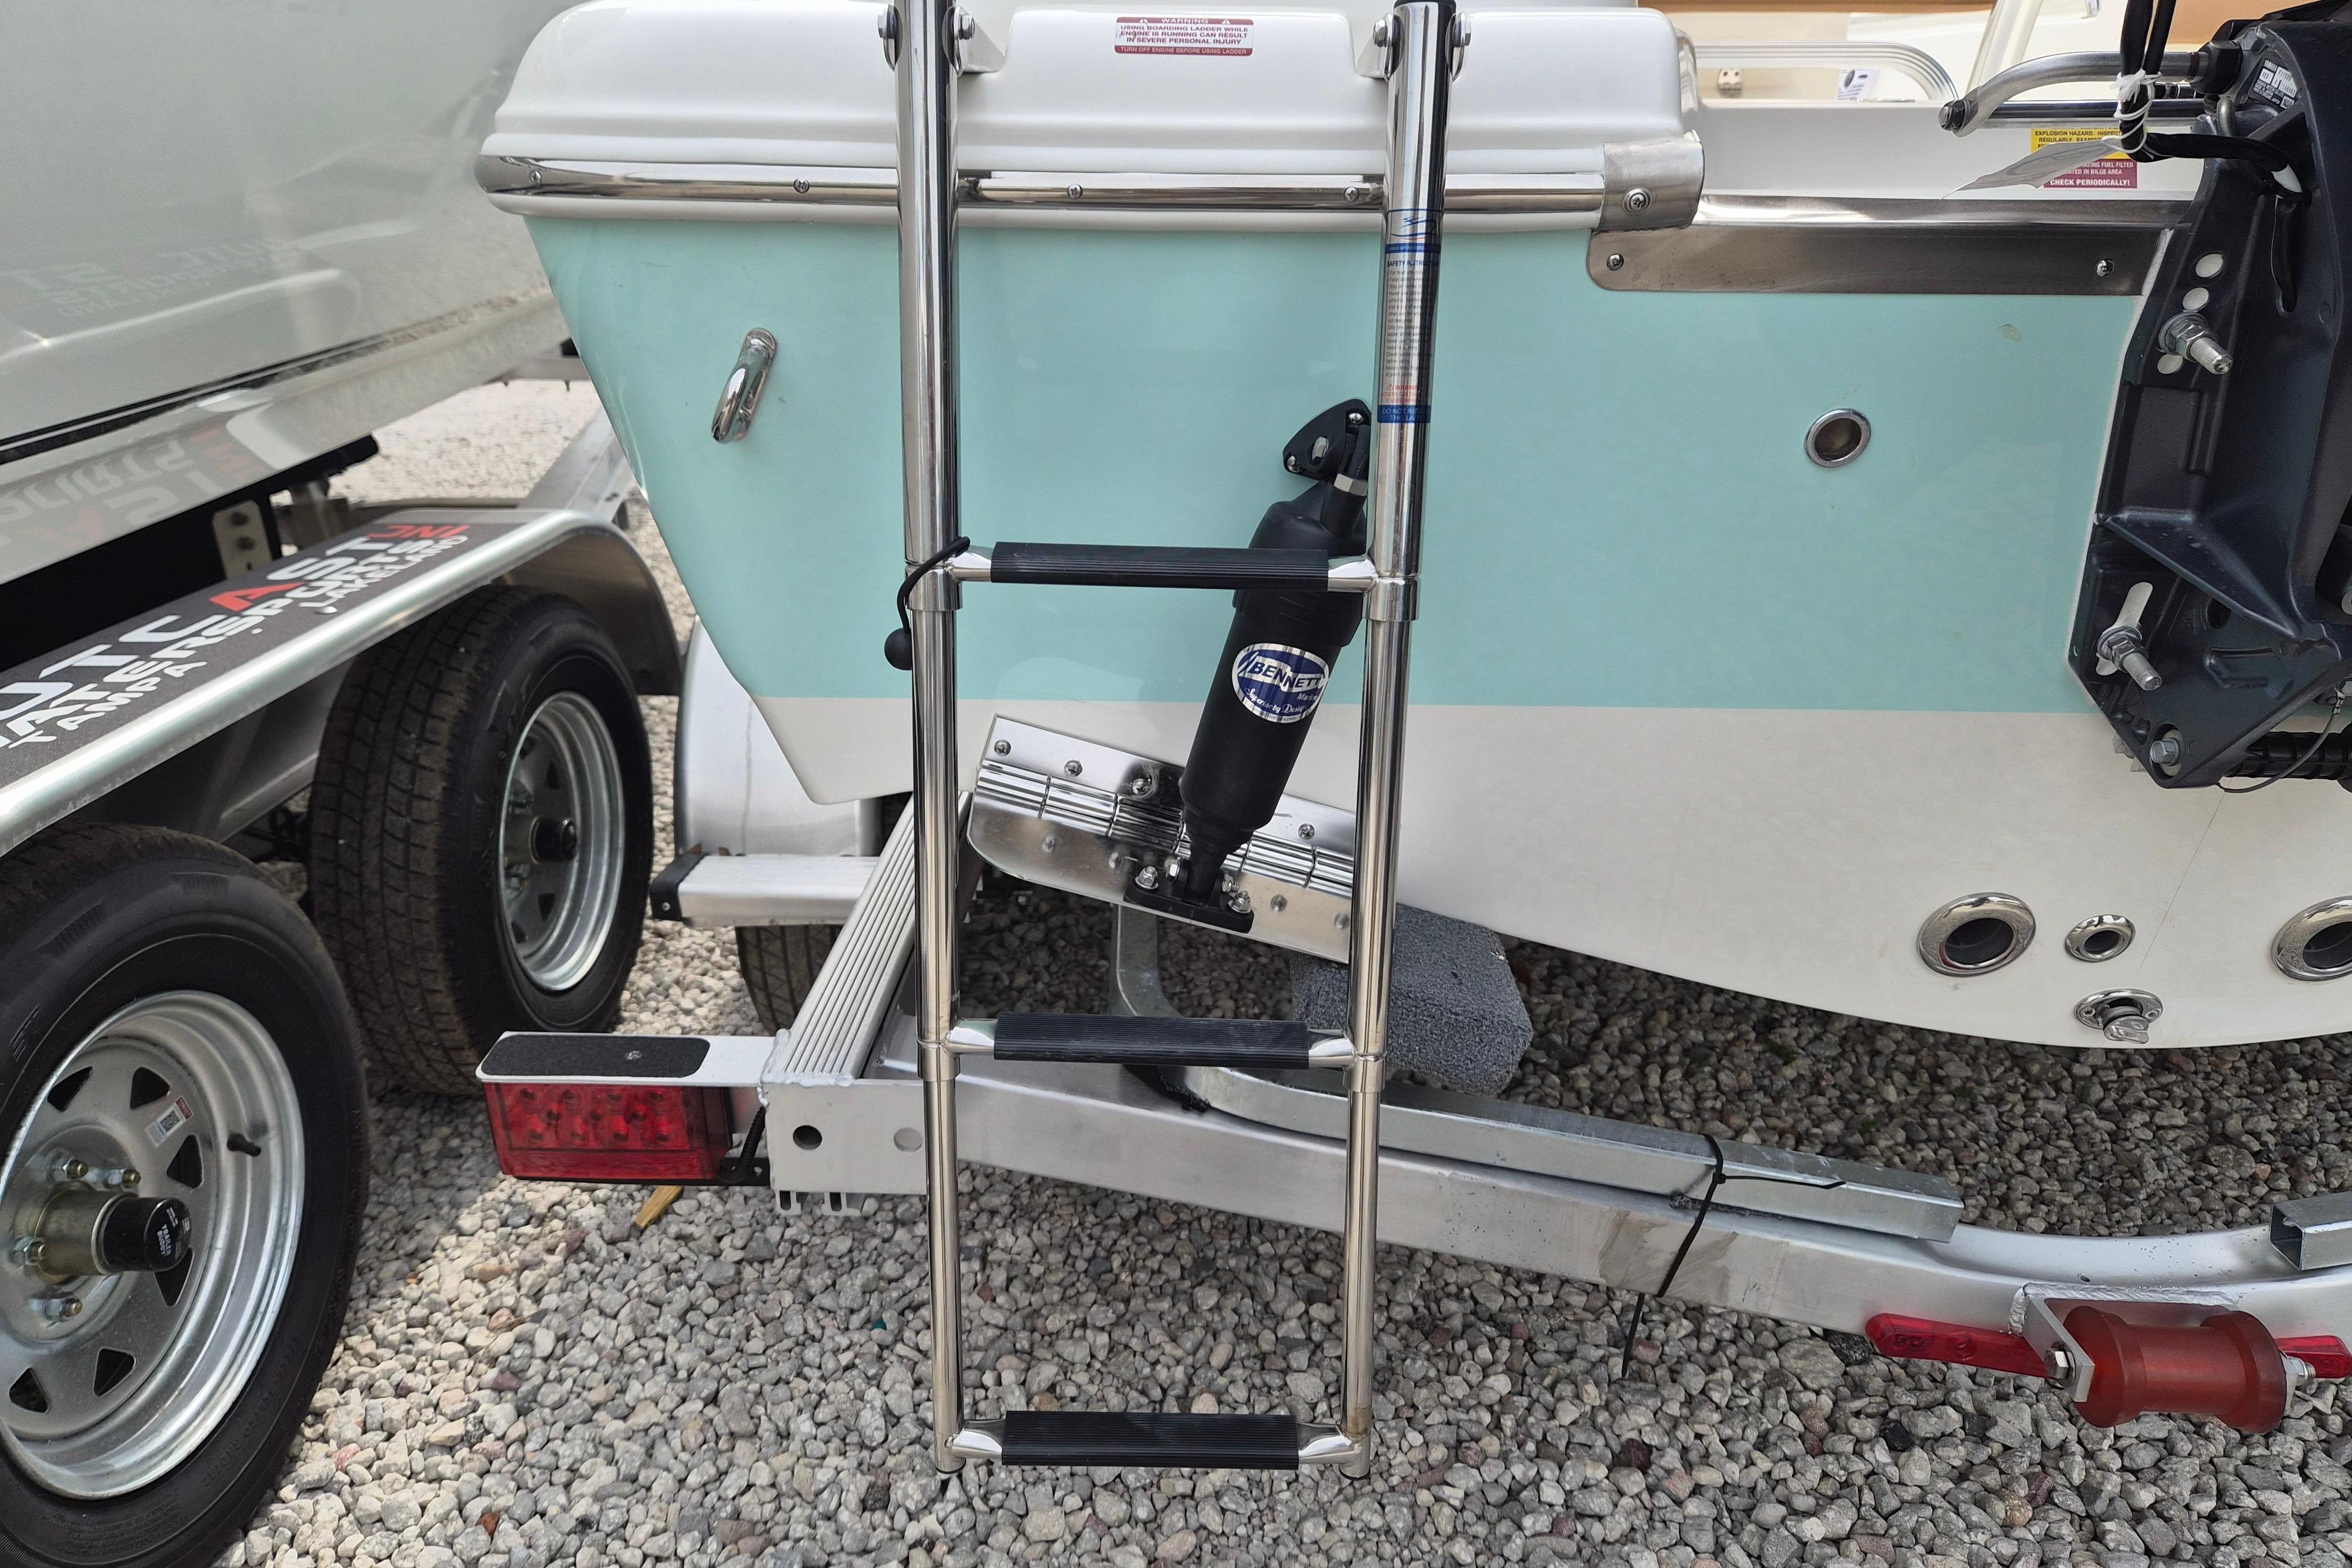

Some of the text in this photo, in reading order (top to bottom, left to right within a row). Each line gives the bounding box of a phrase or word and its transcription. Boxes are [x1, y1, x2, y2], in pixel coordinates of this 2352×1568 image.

[0, 536, 396, 721] UTCAST
[0, 539, 434, 748] ATERSPORTS
[8, 534, 469, 748] TAMPA LAKELAND
[1247, 661, 1321, 688] BENNETT
[1244, 687, 1307, 713] Superior by Design
[157, 1230, 166, 1258] BUDDY
[162, 1223, 171, 1256] TRAILER
